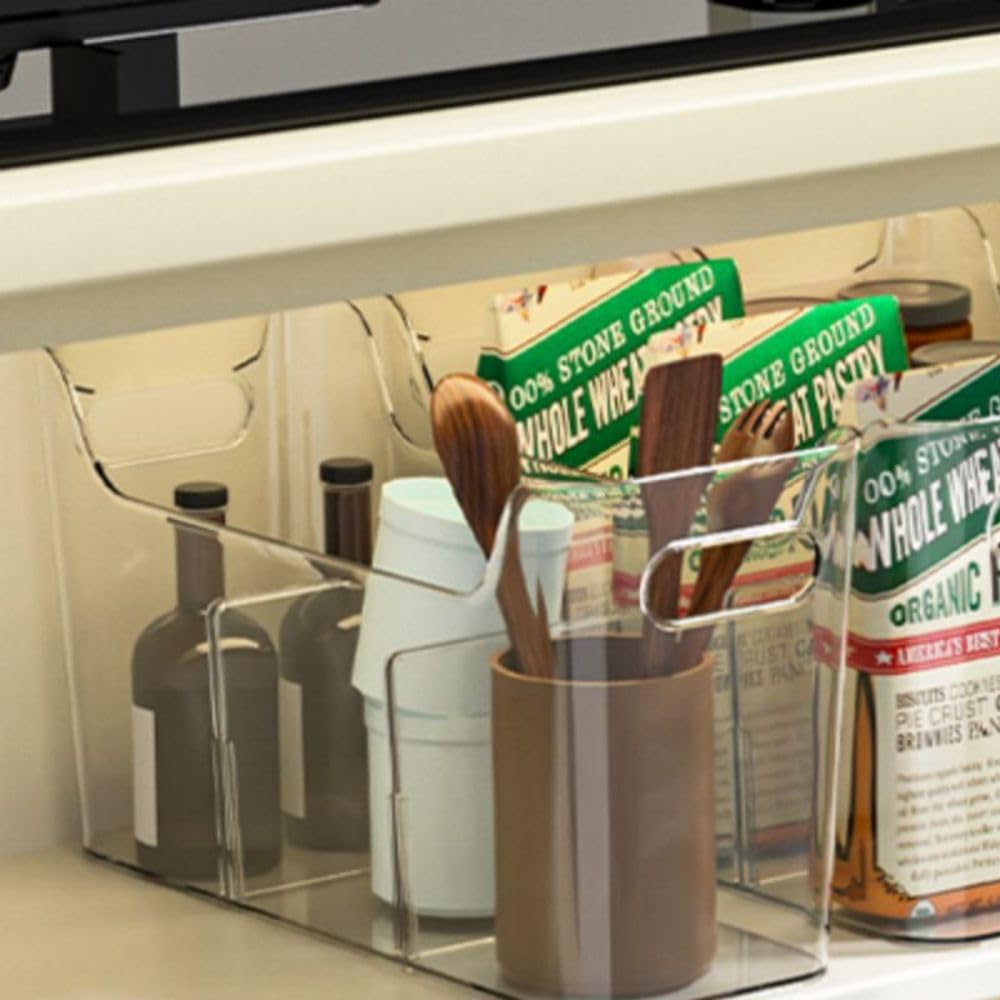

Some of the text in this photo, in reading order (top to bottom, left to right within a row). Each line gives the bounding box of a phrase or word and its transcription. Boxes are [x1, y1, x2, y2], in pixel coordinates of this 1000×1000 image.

[557, 320, 626, 384] STONE
[628, 265, 715, 336] GROUND
[719, 359, 786, 423] STONE
[789, 302, 875, 375] GROUND
[587, 345, 645, 430] WHEA
[868, 480, 948, 572] WHOLE
[889, 561, 982, 627] ORGANIC
